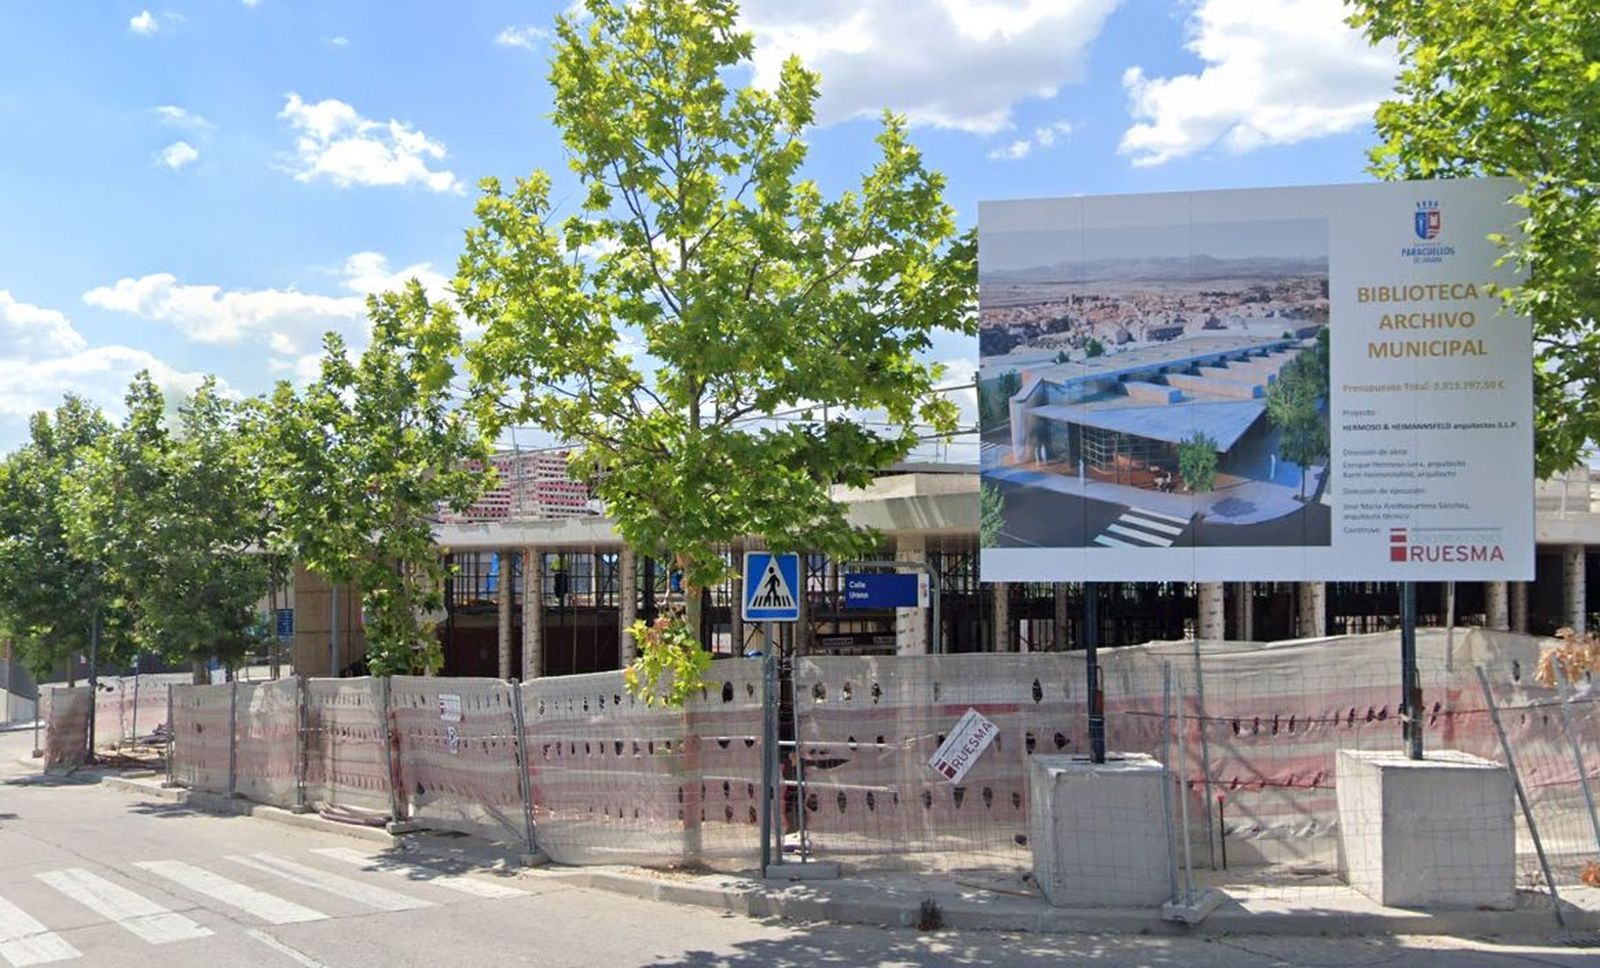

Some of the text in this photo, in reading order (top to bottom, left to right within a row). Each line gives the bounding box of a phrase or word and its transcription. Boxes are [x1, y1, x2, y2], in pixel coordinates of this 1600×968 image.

[1401, 247, 1455, 257] PARACUELLOS
[1357, 283, 1478, 303] BIBLIOTECA
[1378, 311, 1476, 331] ARCHIVO
[1367, 339, 1488, 359] MUNICIPAL
[1343, 384, 1402, 394] Presupuesto
[1410, 545, 1505, 562] RUESMA
[848, 580, 867, 589] Calle
[951, 721, 993, 770] RUESMA
